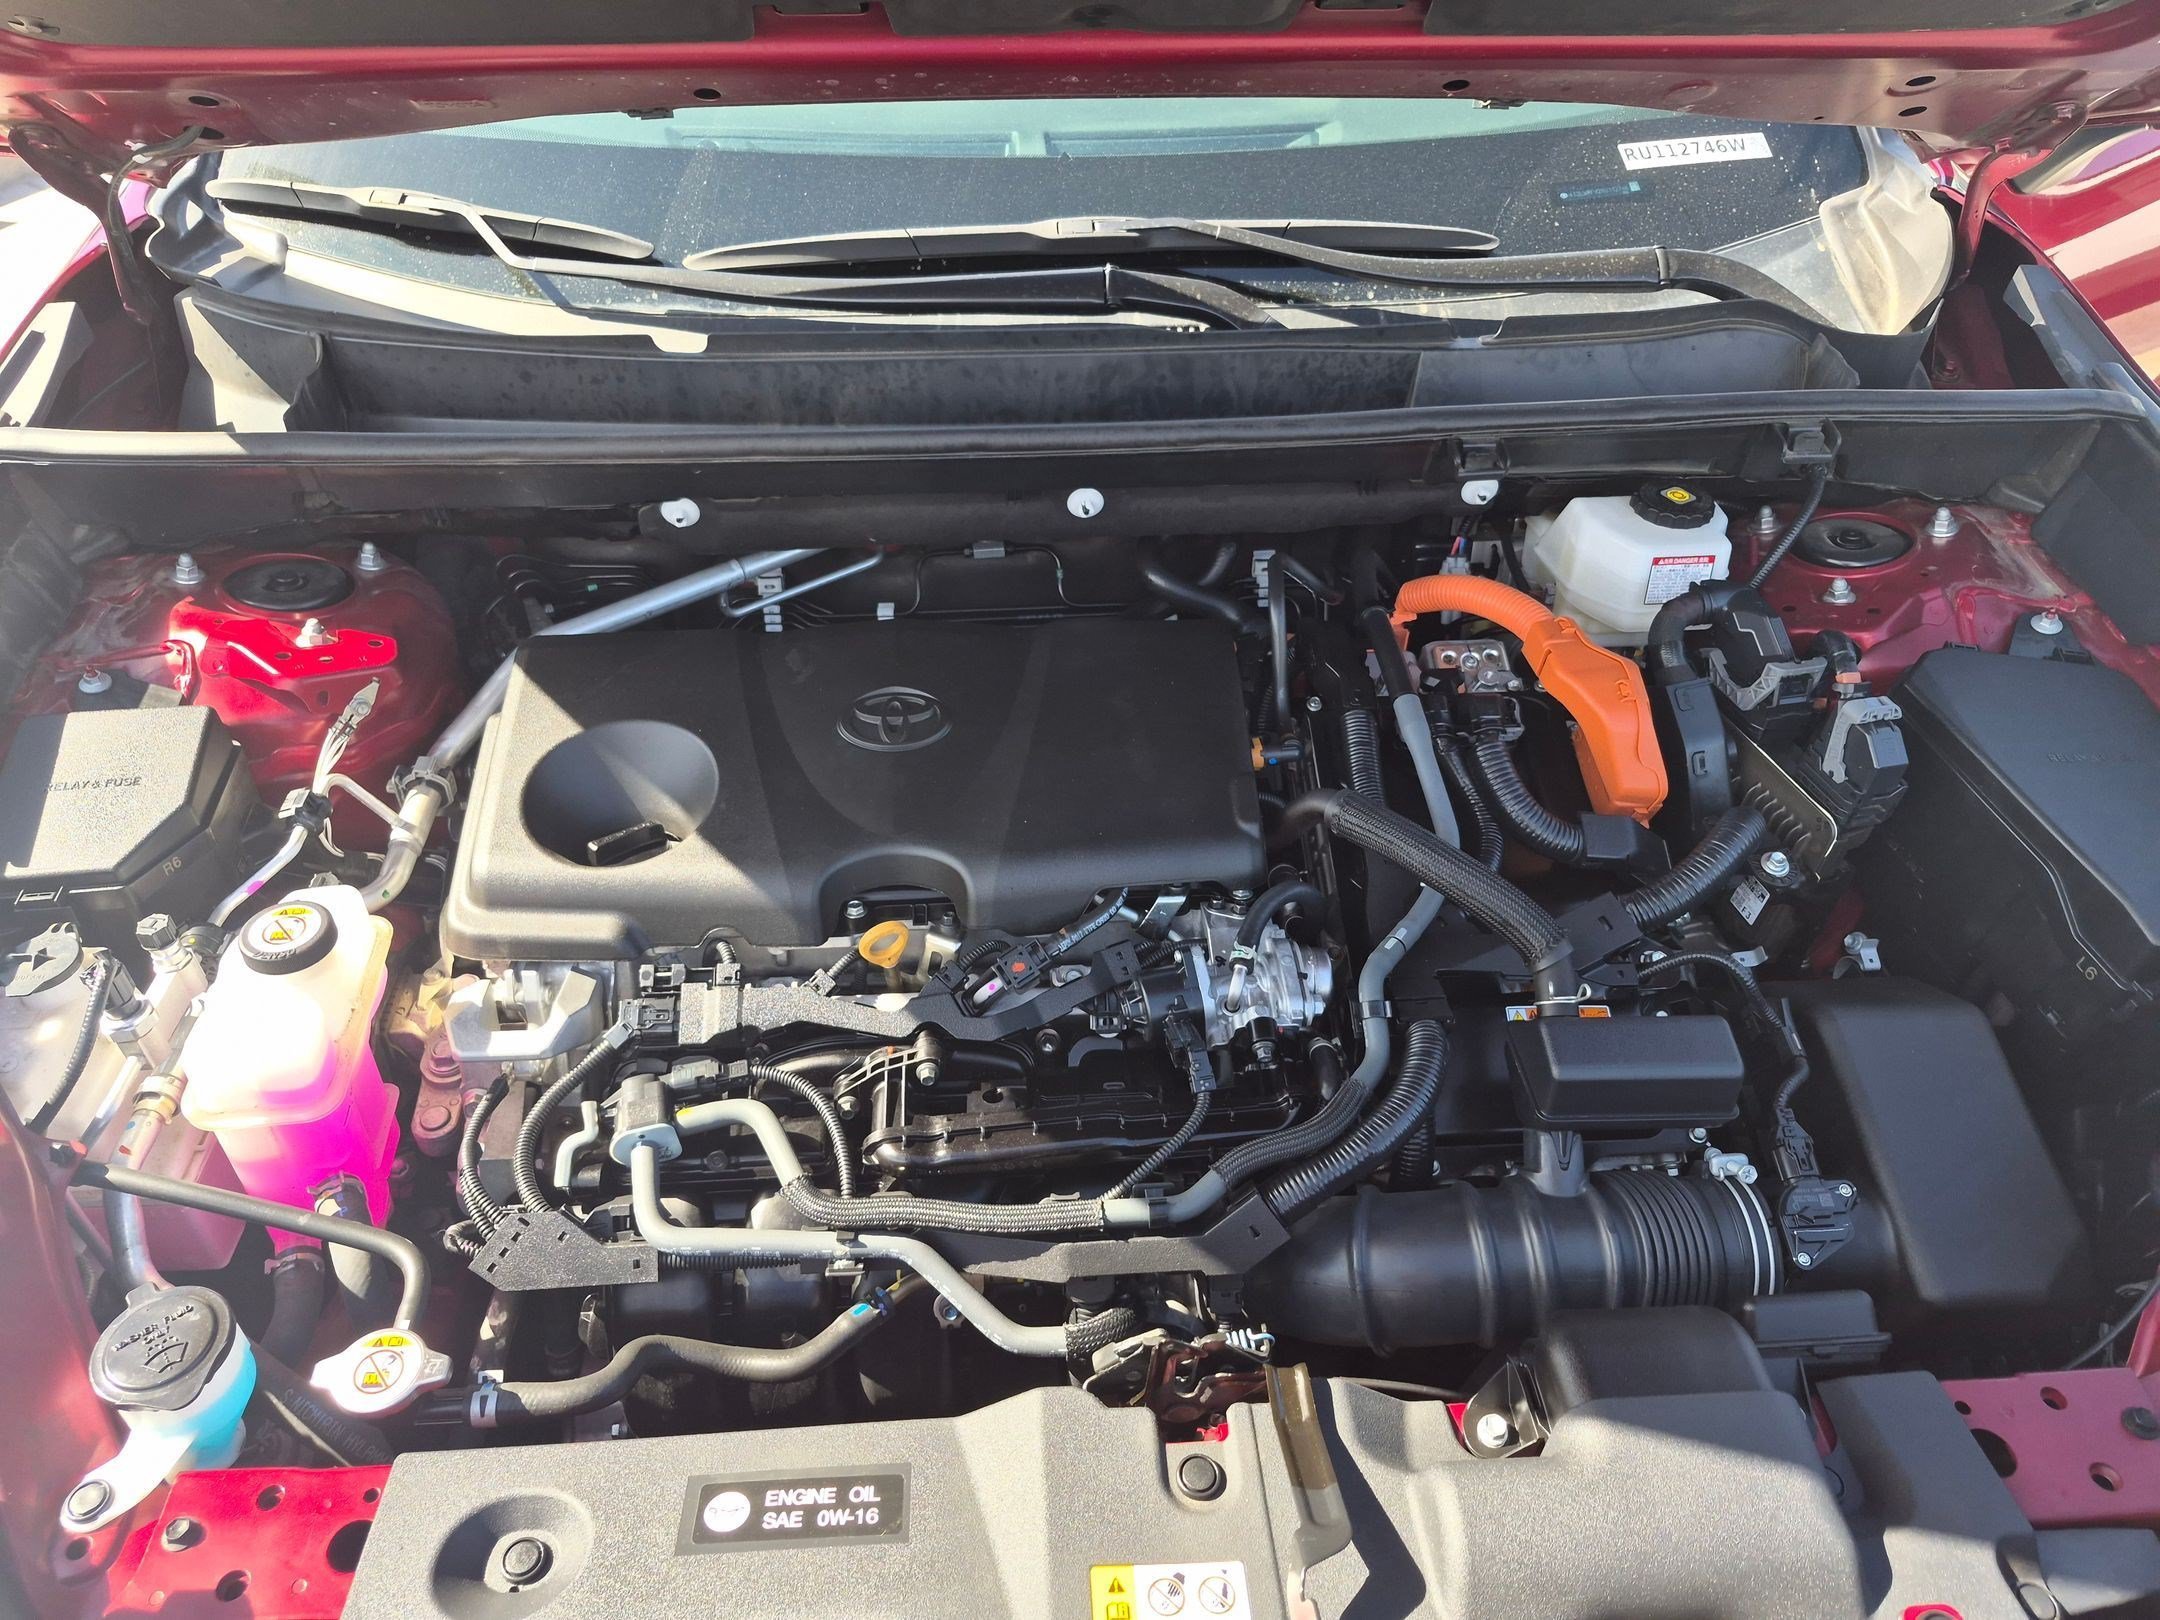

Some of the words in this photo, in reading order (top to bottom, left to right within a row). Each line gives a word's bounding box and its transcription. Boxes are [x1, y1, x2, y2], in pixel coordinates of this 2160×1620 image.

[1623, 137, 1745, 161] RU112746W
[1673, 557, 1699, 565] DANGER
[45, 780, 90, 793] RELAY
[91, 780, 101, 789] &
[104, 776, 142, 787] FUSE
[162, 856, 182, 876] R6
[2075, 956, 2099, 981] L6
[111, 1323, 160, 1352] WASHER
[163, 1304, 194, 1324] FLUID
[142, 1325, 170, 1345] ONLY
[764, 1486, 838, 1507] ENGINE
[848, 1485, 881, 1503] OIL
[761, 1510, 804, 1530] SAE
[816, 1507, 880, 1528] 0W-16
